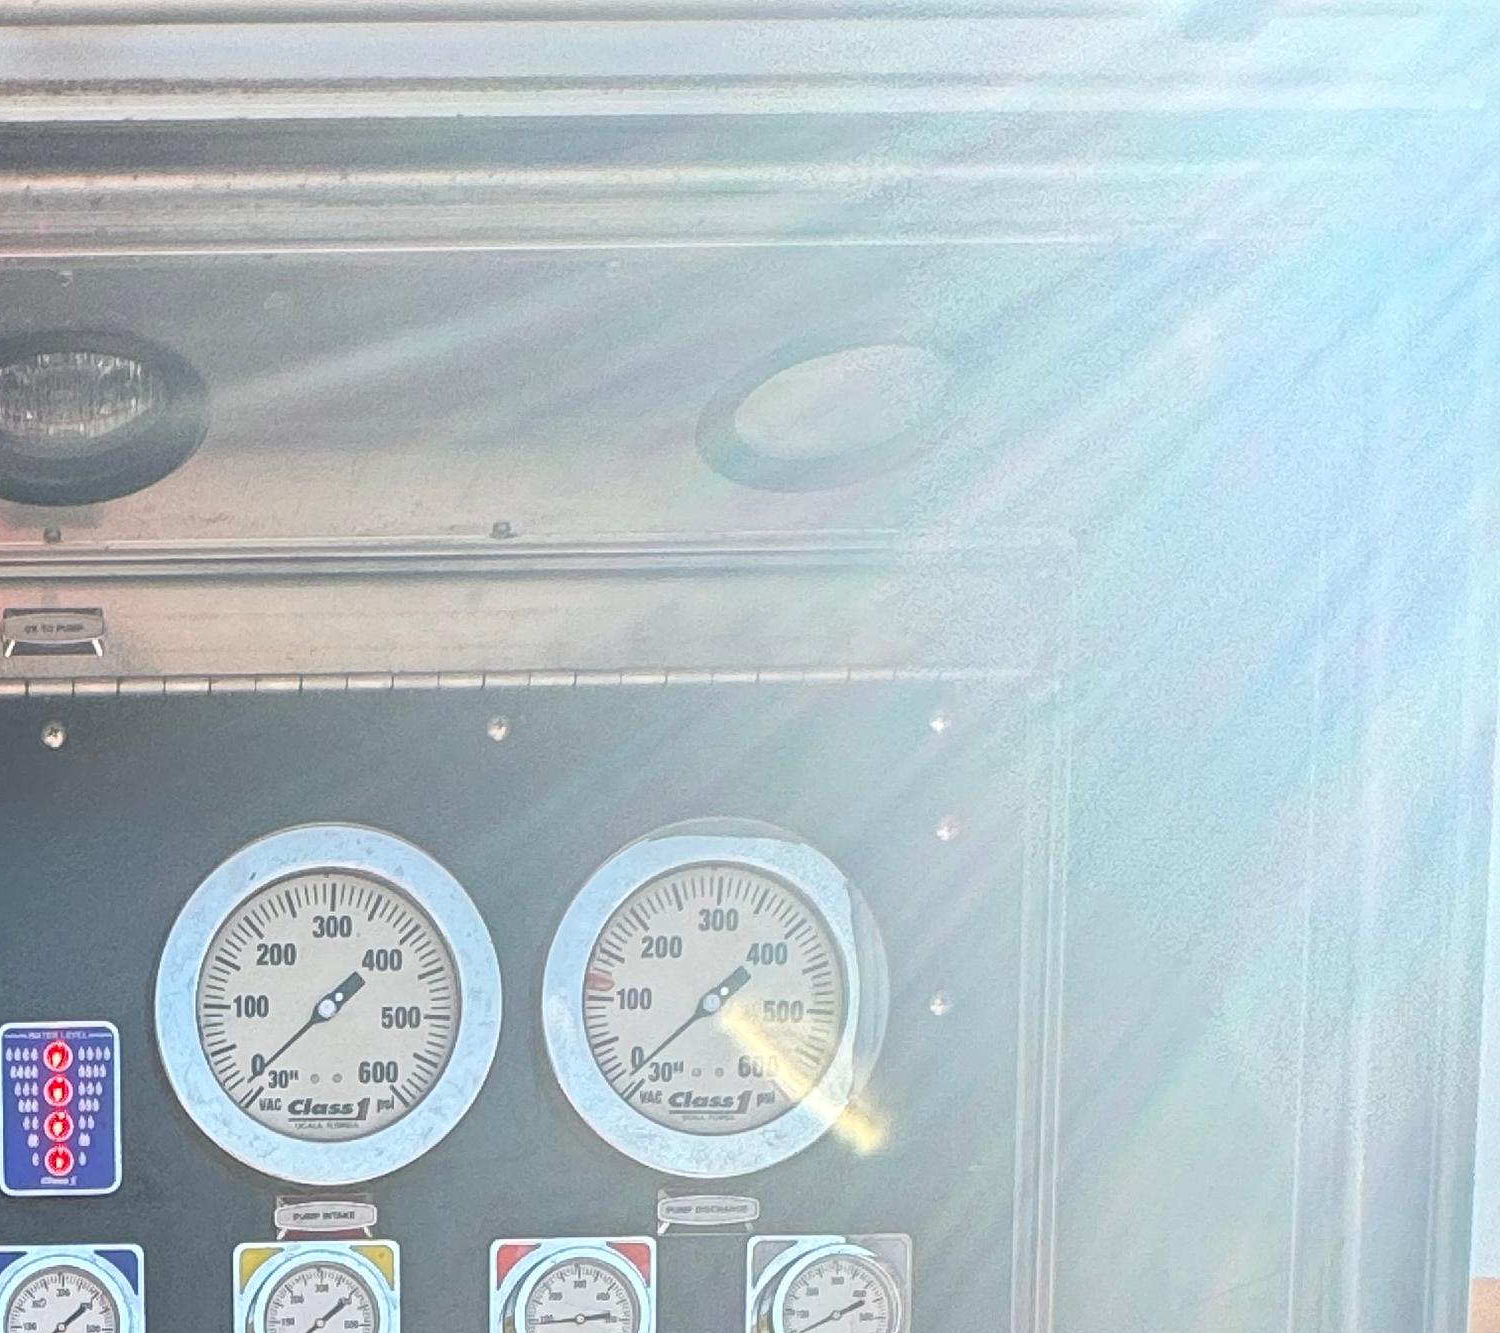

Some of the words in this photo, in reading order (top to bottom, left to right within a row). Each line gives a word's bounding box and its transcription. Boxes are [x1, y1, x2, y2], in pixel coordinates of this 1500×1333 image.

[312, 916, 352, 938] 300
[698, 909, 738, 932] 300
[256, 943, 296, 966] 200
[641, 935, 682, 958] 200
[746, 943, 787, 965] 400
[362, 949, 402, 971] 400
[233, 995, 269, 1018] 100
[617, 988, 651, 1009] 100
[382, 1007, 420, 1029] 500
[763, 1000, 803, 1023] 500
[251, 1054, 265, 1076] 0
[631, 1047, 644, 1067] 0
[359, 1062, 398, 1083] 600
[259, 1098, 281, 1111] VAC
